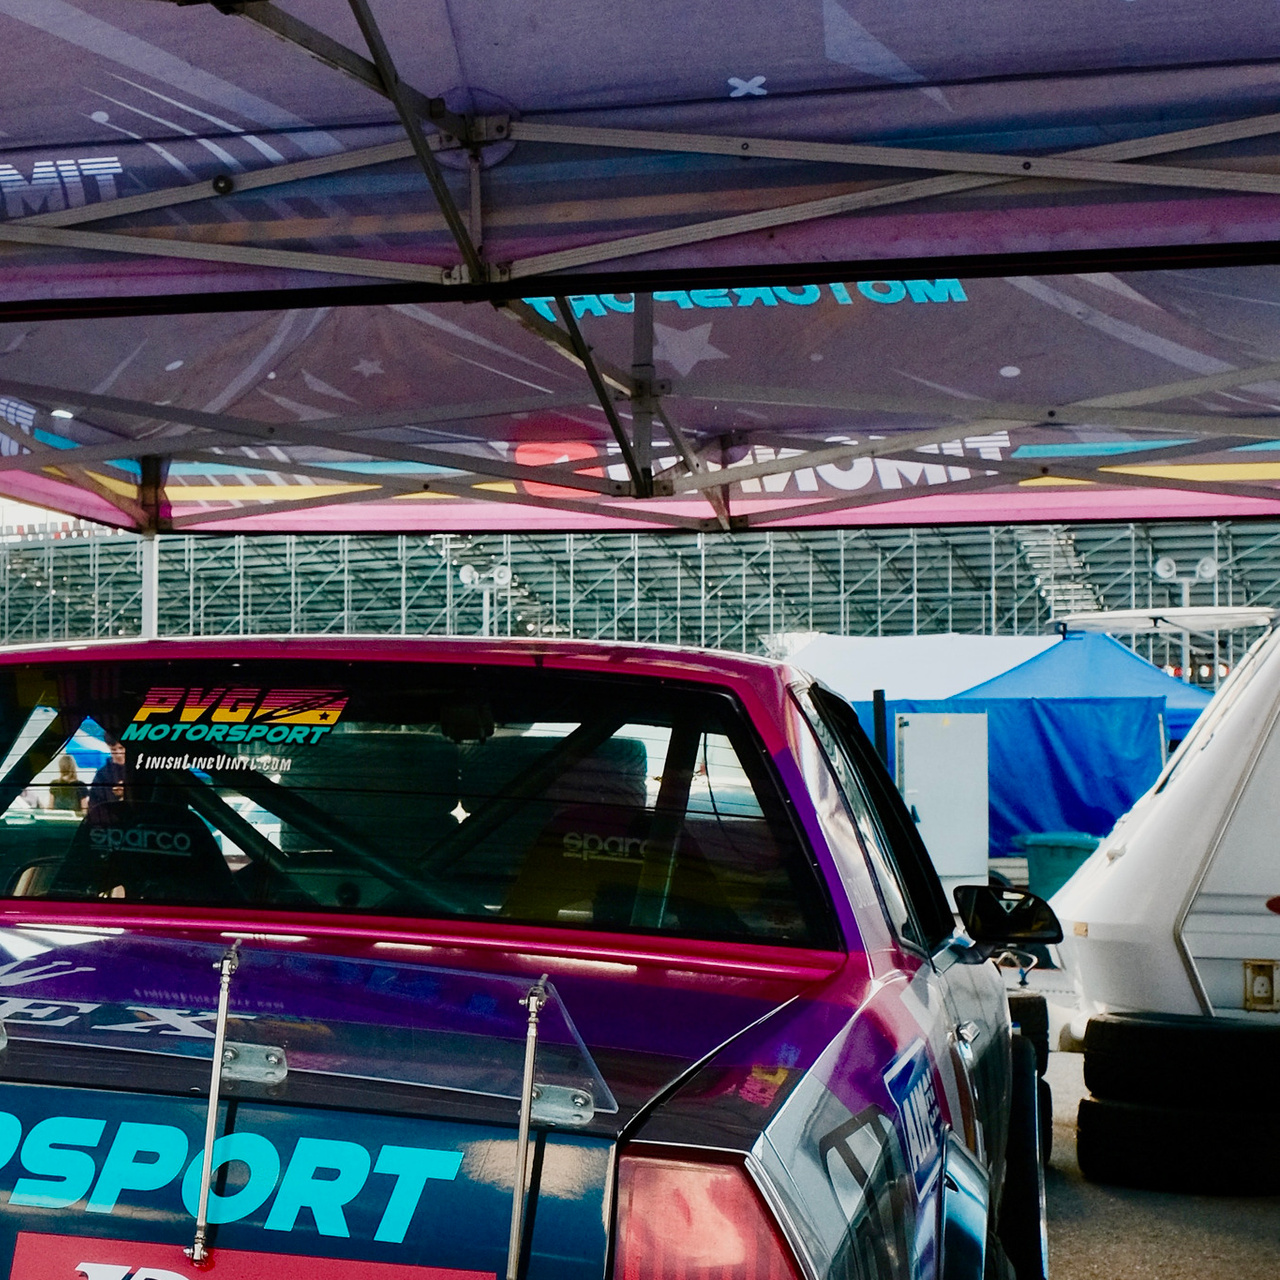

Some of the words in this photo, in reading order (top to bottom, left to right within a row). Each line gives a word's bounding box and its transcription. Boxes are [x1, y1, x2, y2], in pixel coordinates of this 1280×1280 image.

[132, 687, 262, 723] PVG
[120, 723, 332, 745] MOTORSPORT
[88, 827, 192, 854] sparco
